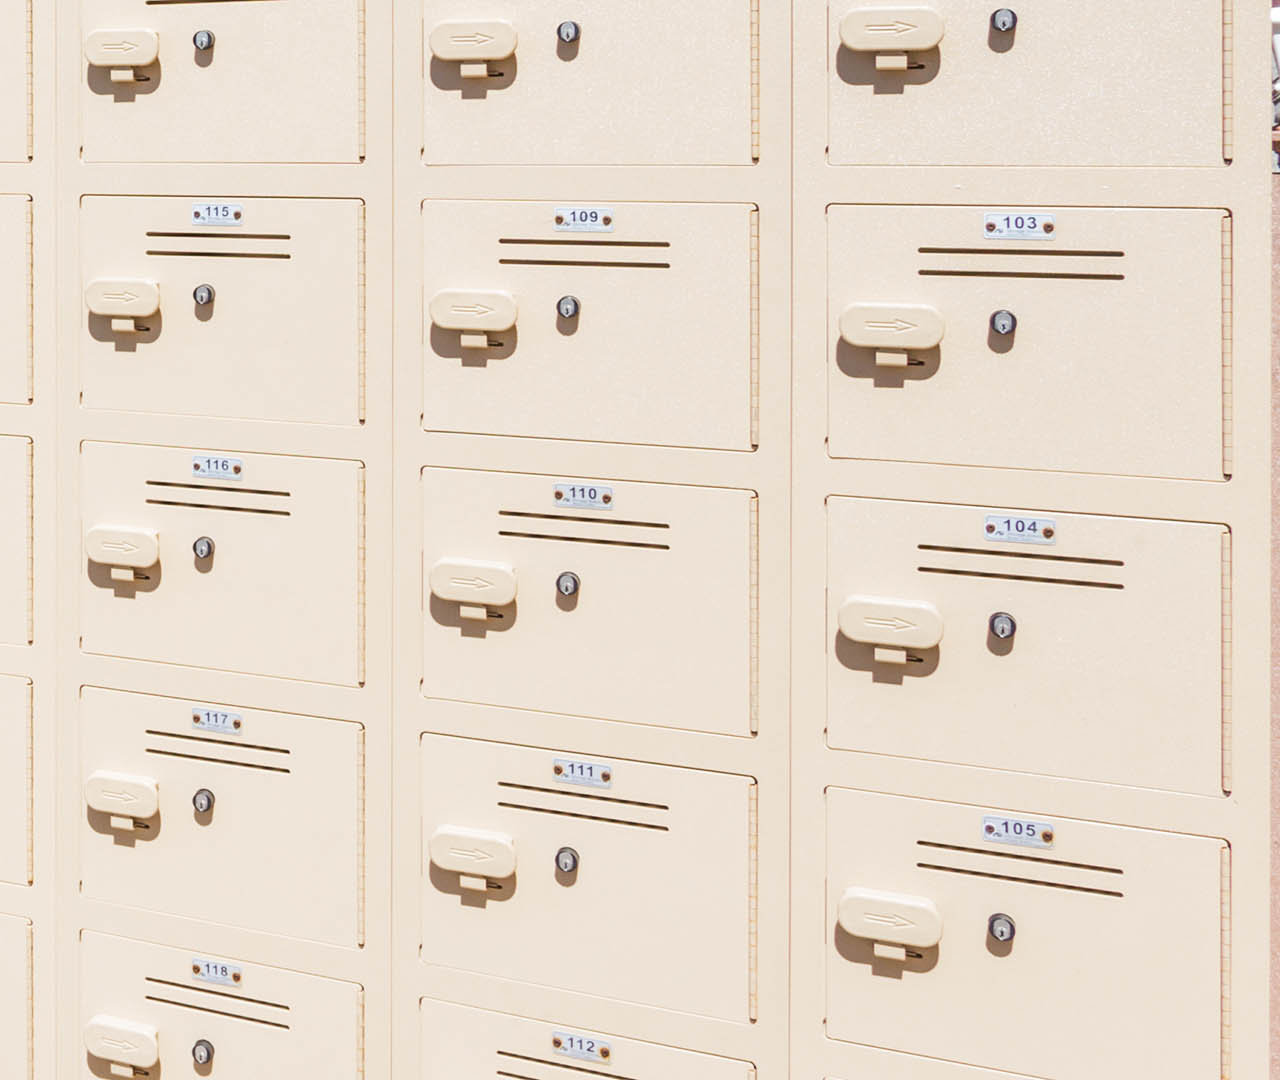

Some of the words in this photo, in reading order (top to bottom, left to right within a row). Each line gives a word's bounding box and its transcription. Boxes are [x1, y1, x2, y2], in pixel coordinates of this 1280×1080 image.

[206, 206, 229, 217] 115
[570, 211, 598, 222] 109
[1003, 216, 1037, 229] 103
[206, 459, 229, 471] 116
[570, 487, 597, 500] 110
[1003, 519, 1038, 533] 104
[205, 712, 228, 724] 117
[569, 763, 593, 777] 111
[1002, 821, 1036, 837] 105
[205, 963, 228, 976] 118
[568, 1037, 595, 1053] 112
